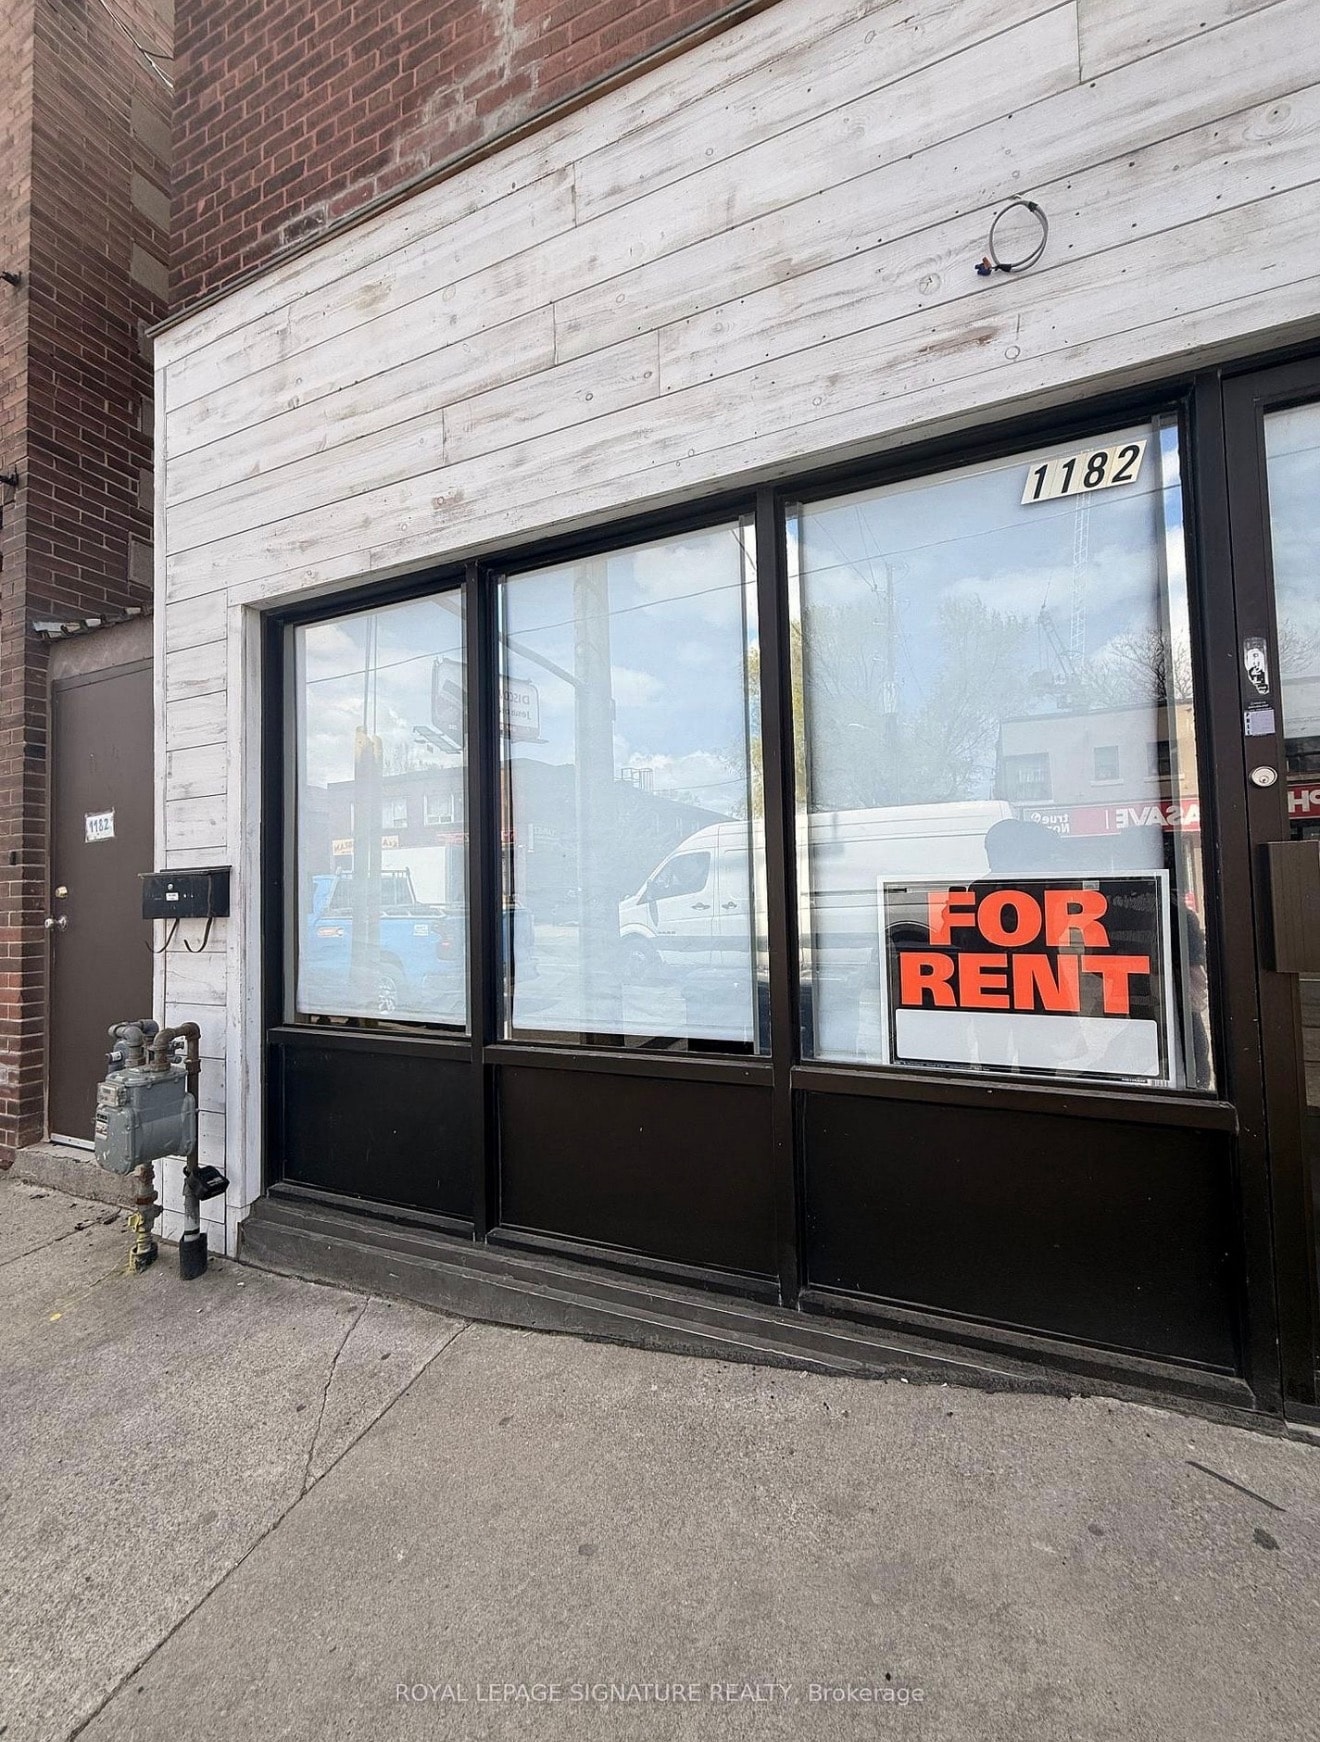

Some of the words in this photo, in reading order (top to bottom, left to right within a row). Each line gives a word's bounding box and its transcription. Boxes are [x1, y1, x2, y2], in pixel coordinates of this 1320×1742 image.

[1033, 444, 1140, 500] 1182
[89, 817, 109, 833] 1182
[928, 889, 1111, 948] FOR
[899, 951, 1150, 1014] RENT
